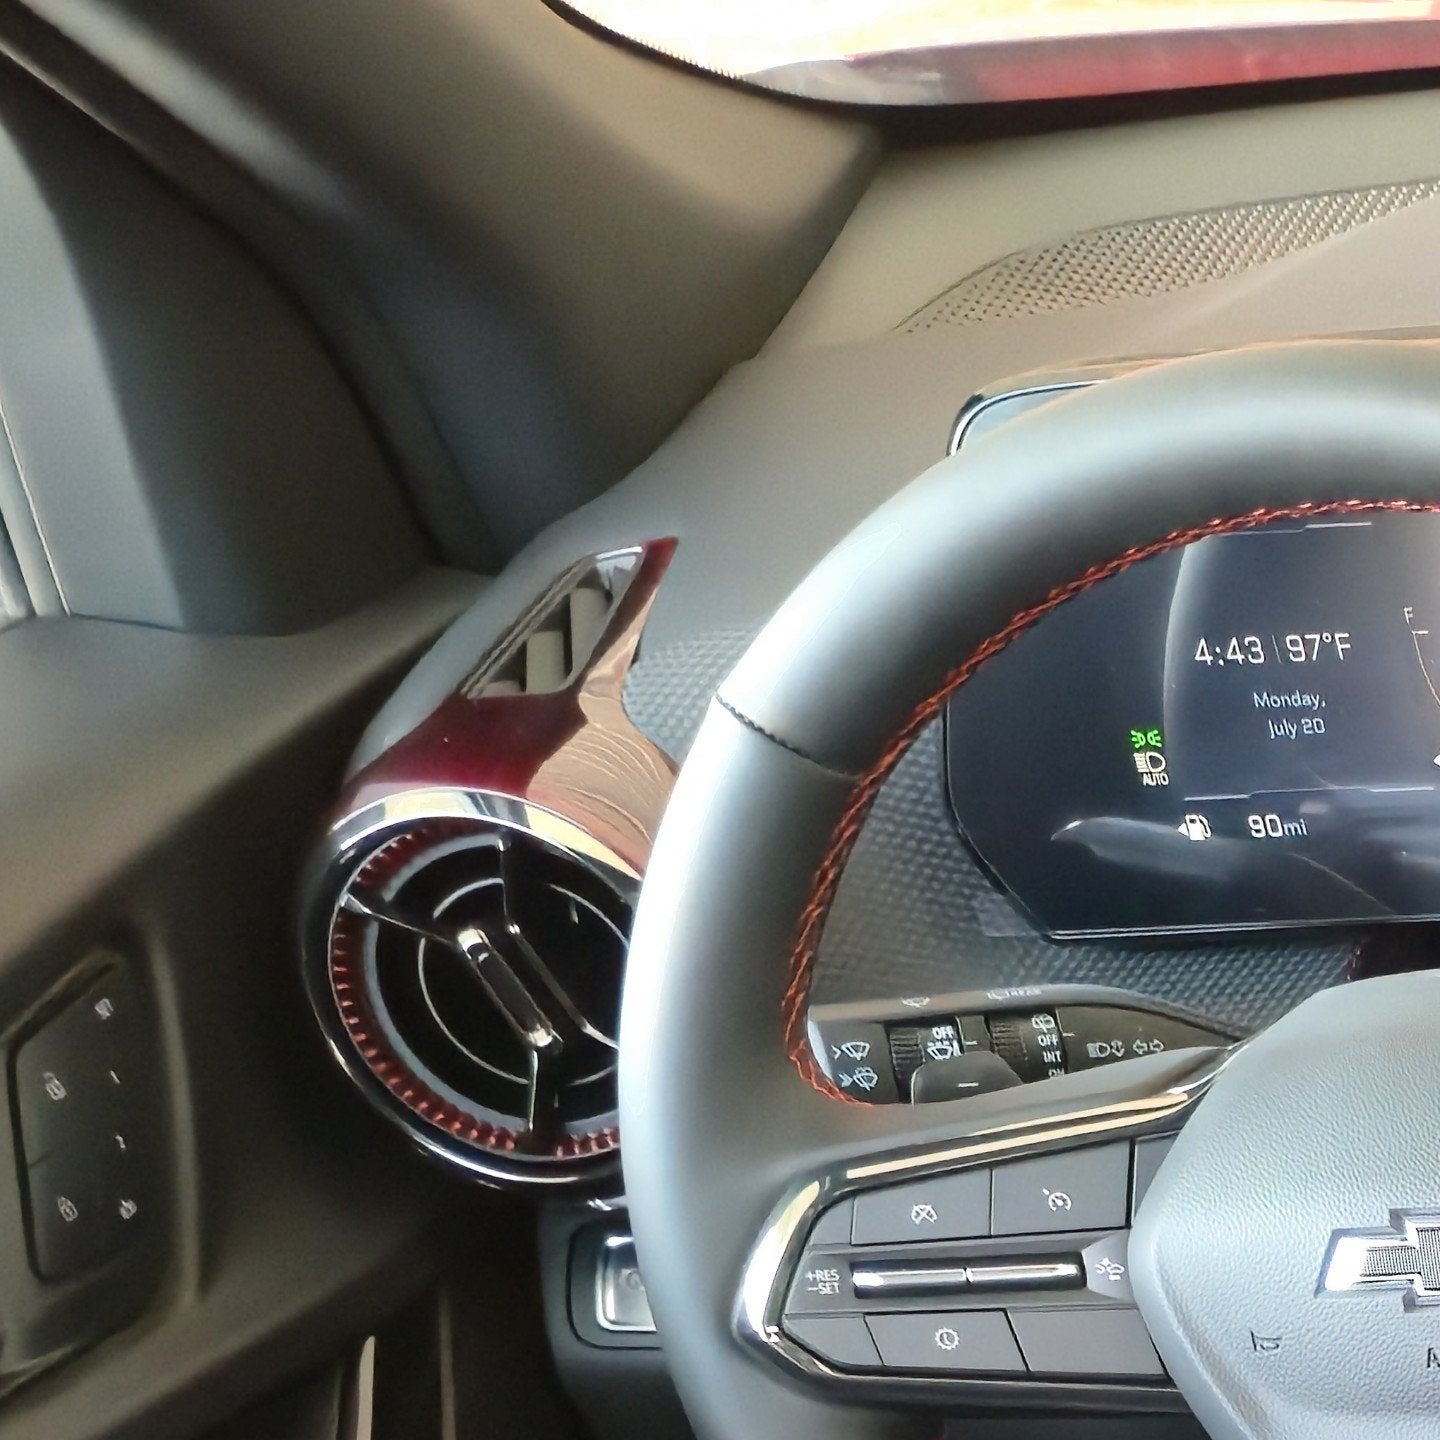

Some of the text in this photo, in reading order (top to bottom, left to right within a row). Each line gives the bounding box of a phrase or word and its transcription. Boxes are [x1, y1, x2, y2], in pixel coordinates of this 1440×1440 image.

[1194, 632, 1351, 666] 4:43 97°F
[1253, 690, 1326, 710] Monday,
[1269, 717, 1326, 740] July 20
[1142, 772, 1169, 786] AUTO
[932, 1025, 954, 1039] OFF
[1037, 1034, 1059, 1047] OFF
[1043, 1050, 1062, 1063] INT
